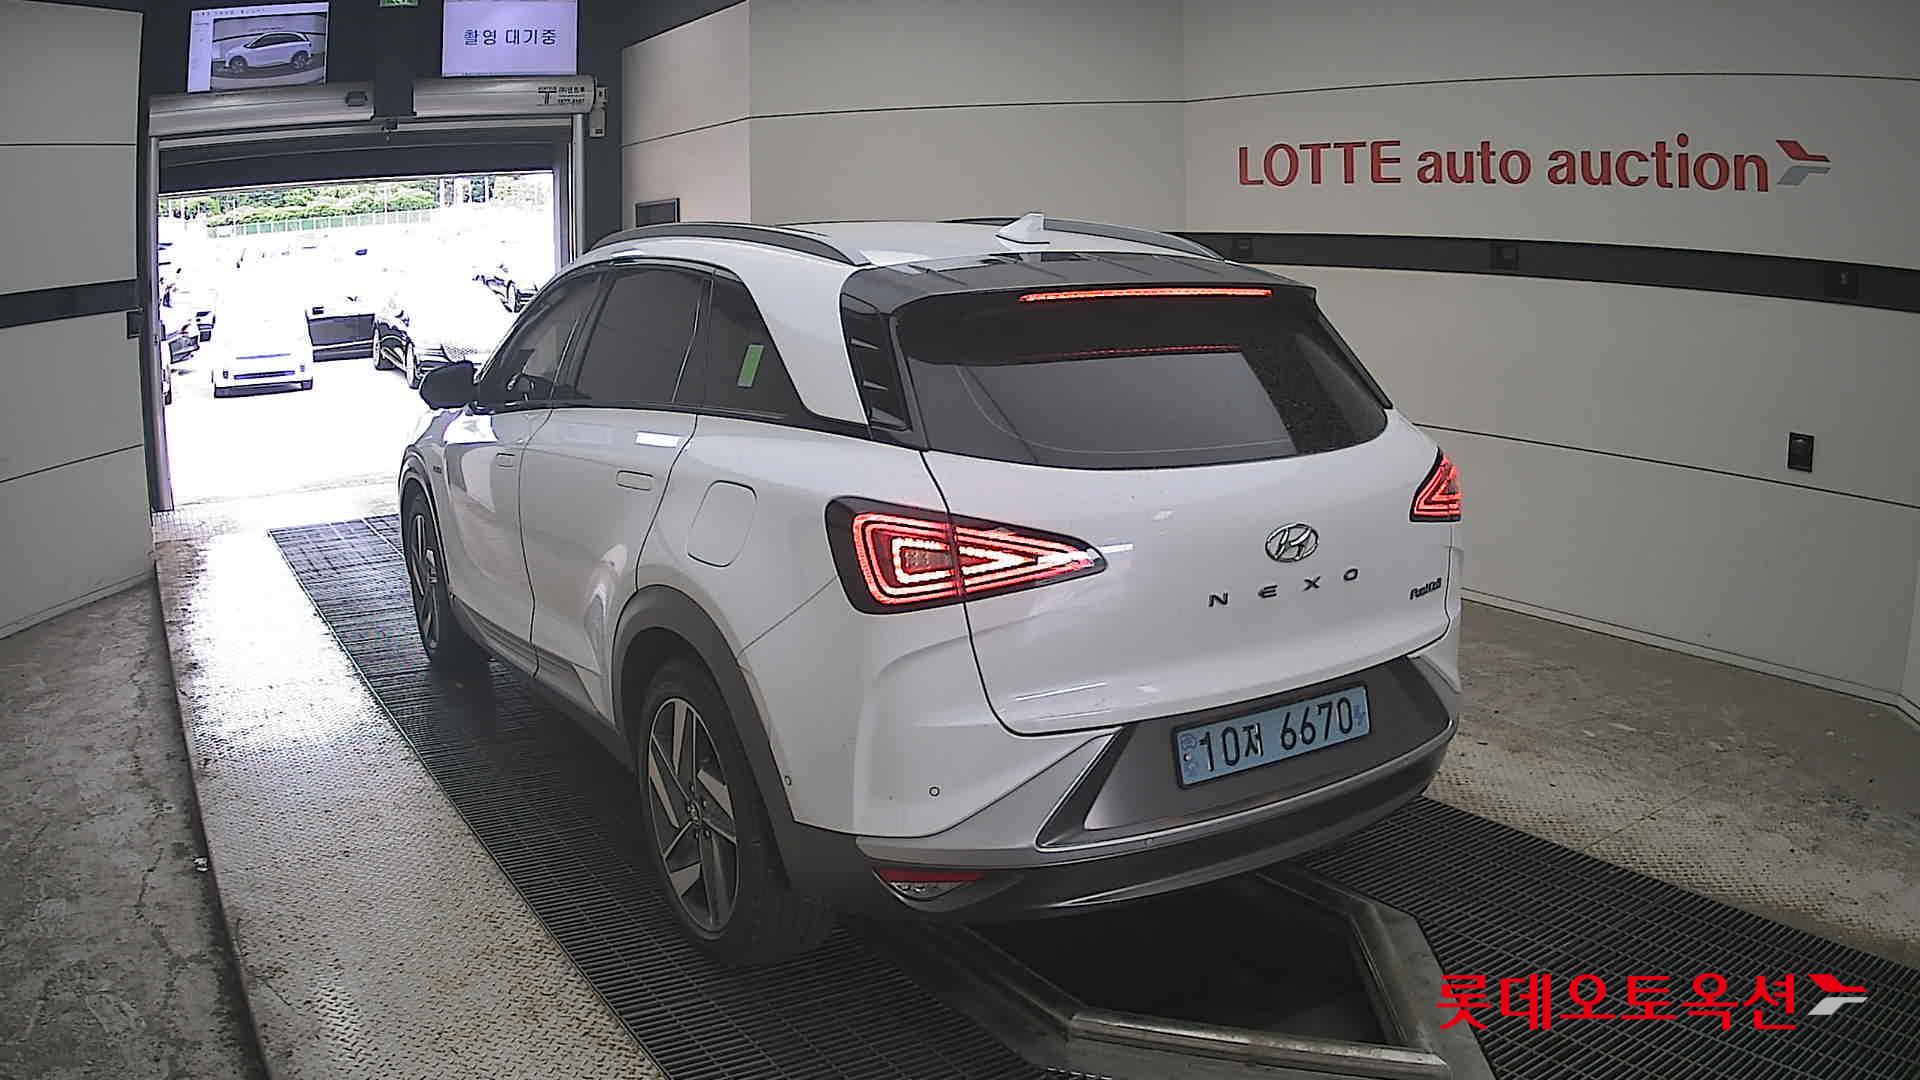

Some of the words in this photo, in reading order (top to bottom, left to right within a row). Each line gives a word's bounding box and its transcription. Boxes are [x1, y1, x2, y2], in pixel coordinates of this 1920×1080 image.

[464, 29, 498, 46] 촬영
[505, 29, 556, 46] 대기중
[1239, 141, 1401, 187] LOTTE
[1417, 141, 1532, 185] auto
[1547, 132, 1769, 193] auction
[1199, 721, 1264, 772] 10저
[1280, 696, 1354, 751] 6670
